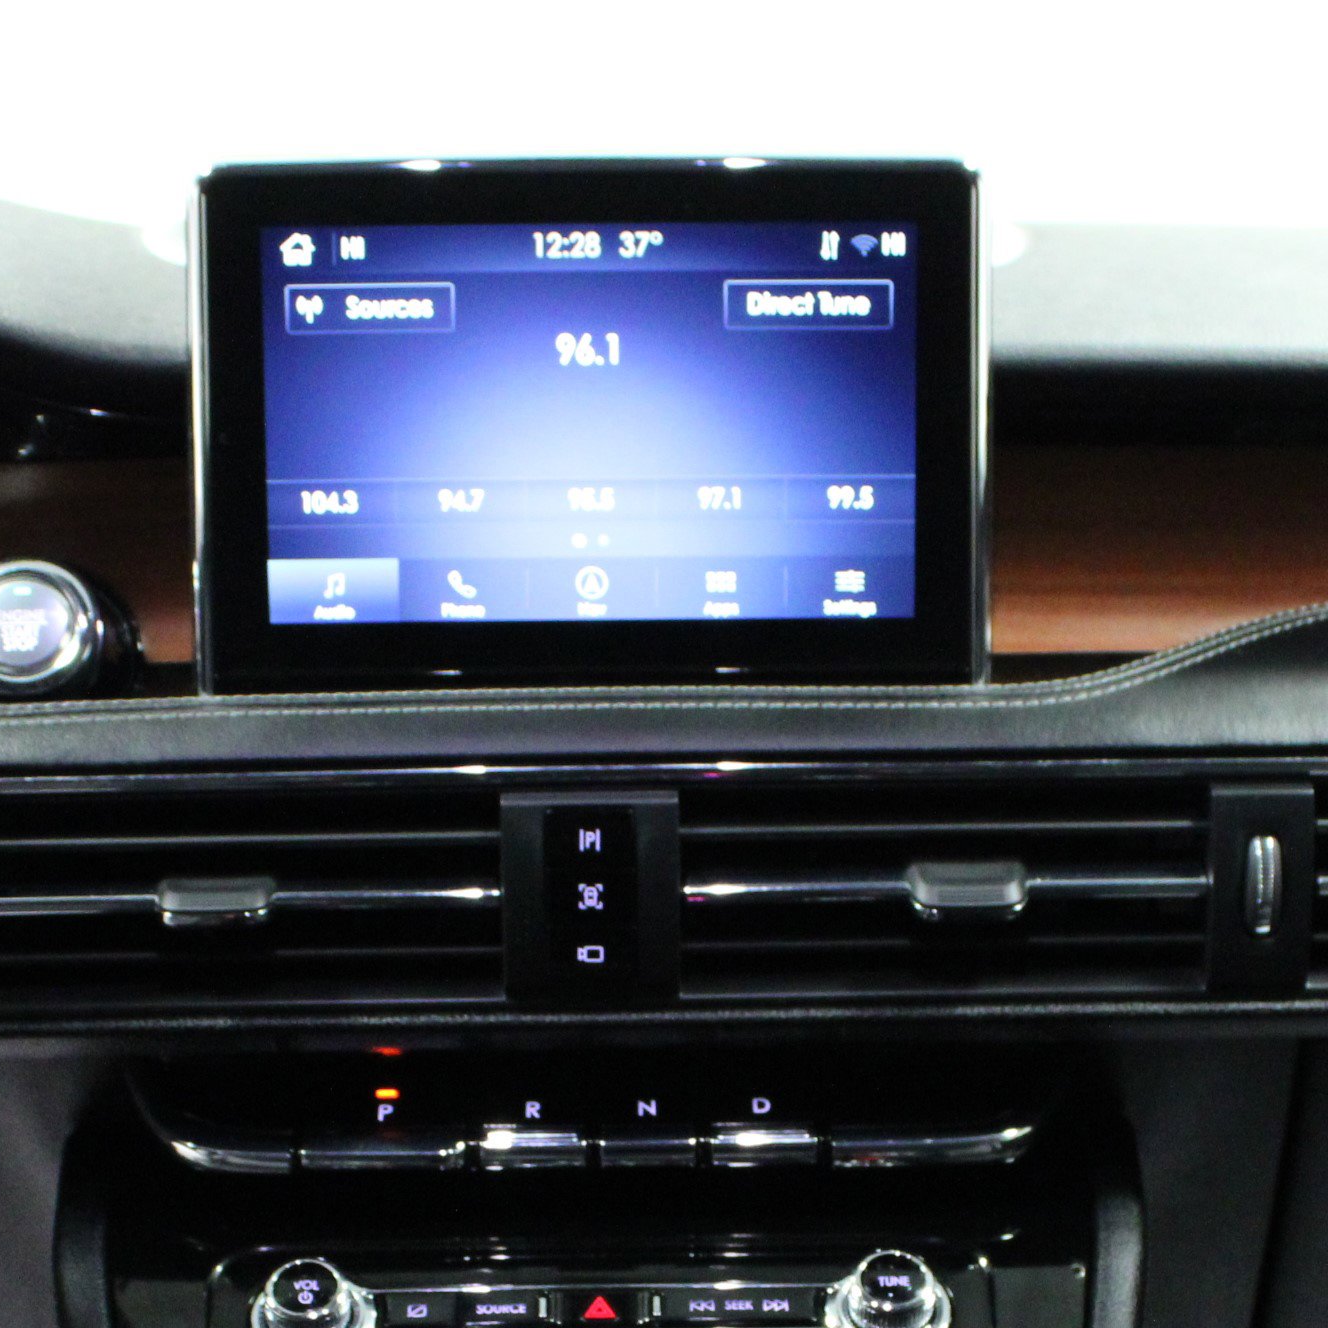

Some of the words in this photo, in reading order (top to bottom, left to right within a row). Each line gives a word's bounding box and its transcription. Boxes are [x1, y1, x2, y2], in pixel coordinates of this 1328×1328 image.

[533, 231, 602, 259] 12:28
[619, 230, 664, 259] 37°
[345, 294, 435, 321] Sources
[746, 290, 814, 317] Direct
[816, 290, 872, 317] Tune
[555, 332, 621, 367] 96.1
[300, 489, 360, 515] 104.3
[437, 488, 486, 513] 94.7
[697, 485, 742, 511] 97.1
[826, 485, 875, 511] 99.5
[376, 1103, 395, 1123] P
[524, 1100, 542, 1119] R
[636, 1099, 657, 1117] N
[751, 1096, 772, 1115] D
[293, 1279, 321, 1292] VOL
[877, 1275, 912, 1288] TUNE
[475, 1303, 527, 1316] SOURCE
[724, 1300, 755, 1312] SEEK
